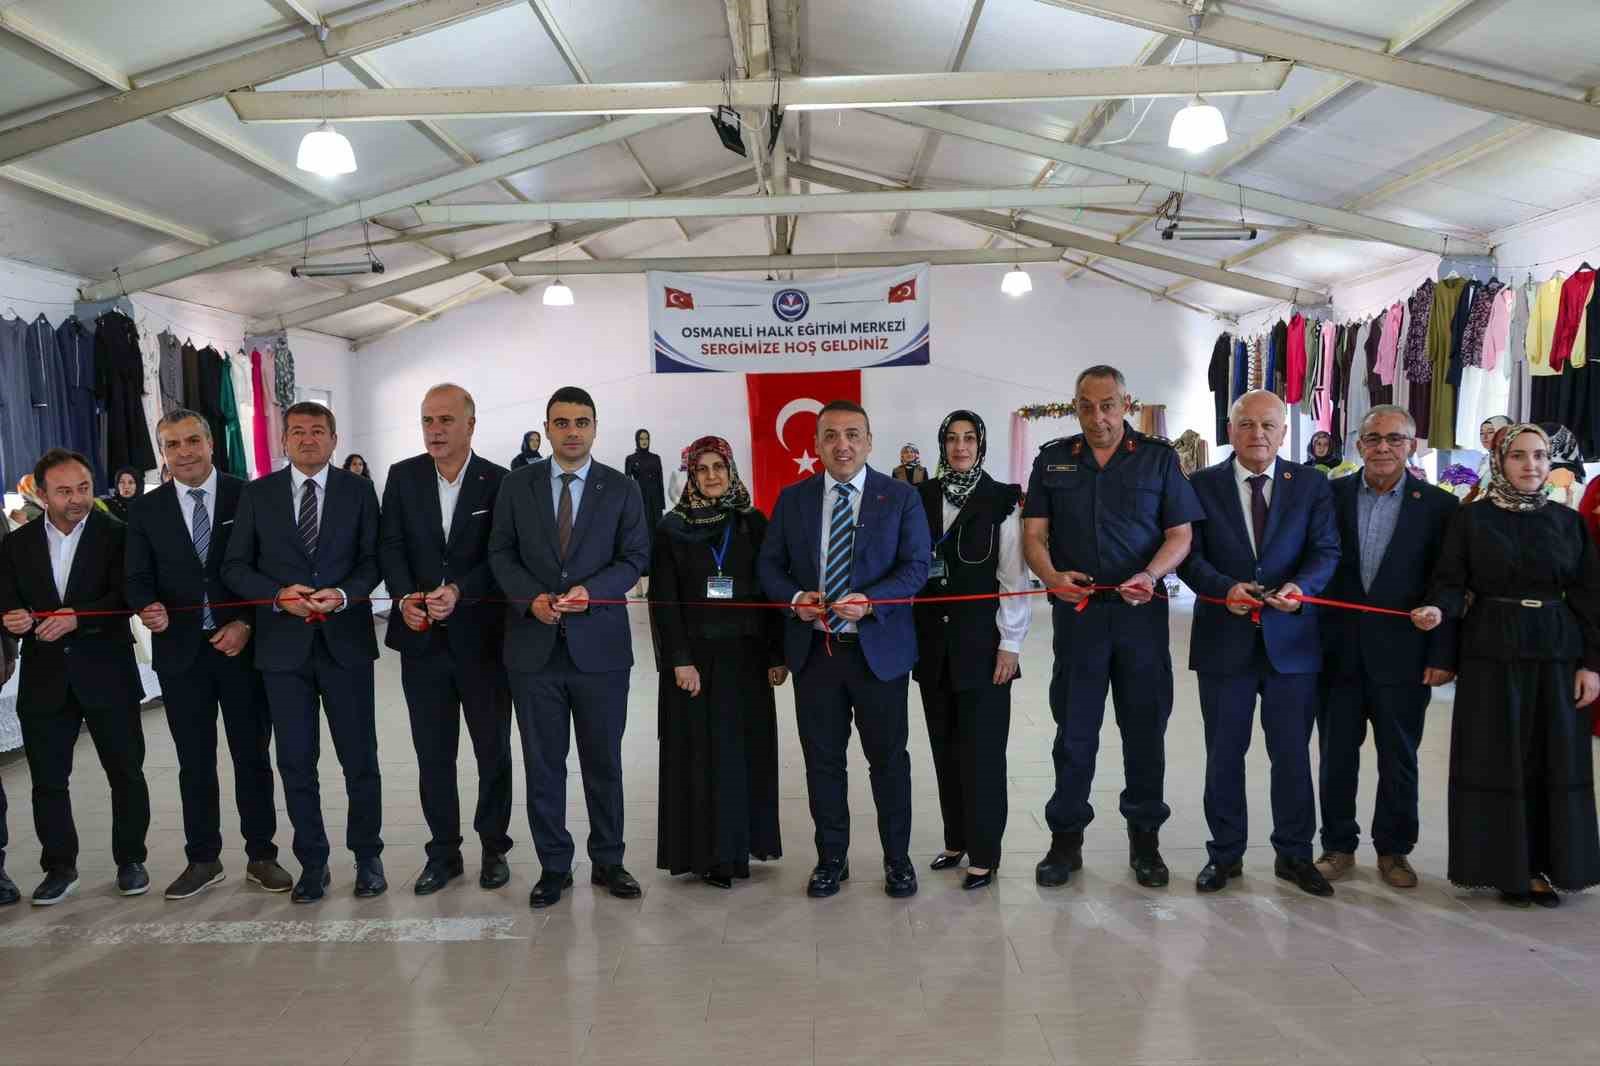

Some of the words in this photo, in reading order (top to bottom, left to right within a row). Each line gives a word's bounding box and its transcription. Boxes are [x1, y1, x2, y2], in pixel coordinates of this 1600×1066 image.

[681, 323, 753, 338] OSMANELİ
[757, 324, 793, 337] HALK
[797, 321, 847, 336] EĞİTİMİ
[850, 318, 906, 334] MERKEZİ
[701, 339, 780, 355] SERGİMİZE
[784, 341, 817, 356] HOŞ
[821, 337, 889, 353] GELDİNİZ
